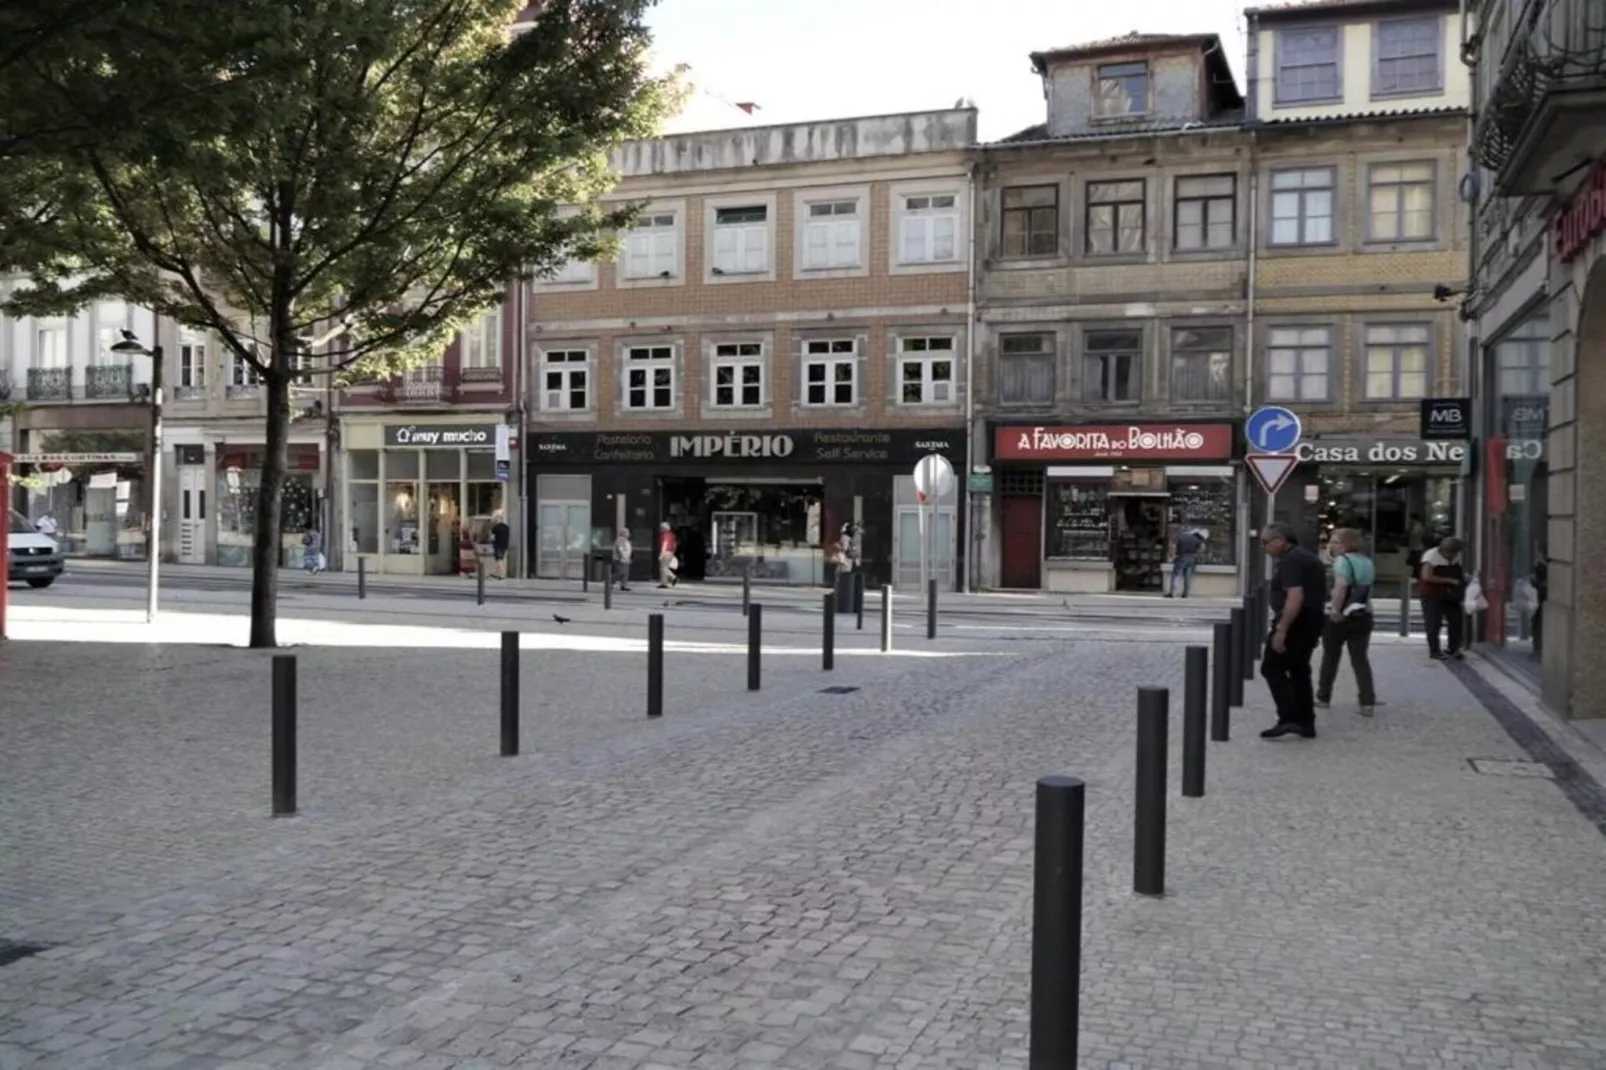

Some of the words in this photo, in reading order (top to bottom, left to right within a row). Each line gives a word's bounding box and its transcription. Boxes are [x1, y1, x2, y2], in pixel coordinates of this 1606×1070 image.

[1431, 408, 1462, 422] MB
[411, 431, 440, 444] muy
[442, 429, 487, 442] mucho
[670, 430, 794, 458] IMPÉRIO
[1018, 433, 1031, 449] A
[1034, 427, 1109, 450] FAVORITA
[1112, 440, 1127, 449] DO
[1128, 427, 1204, 450] BOLHÃO
[816, 448, 840, 459] Self
[842, 448, 888, 459] Service
[1294, 443, 1359, 462] Casa
[1368, 442, 1416, 462] dos
